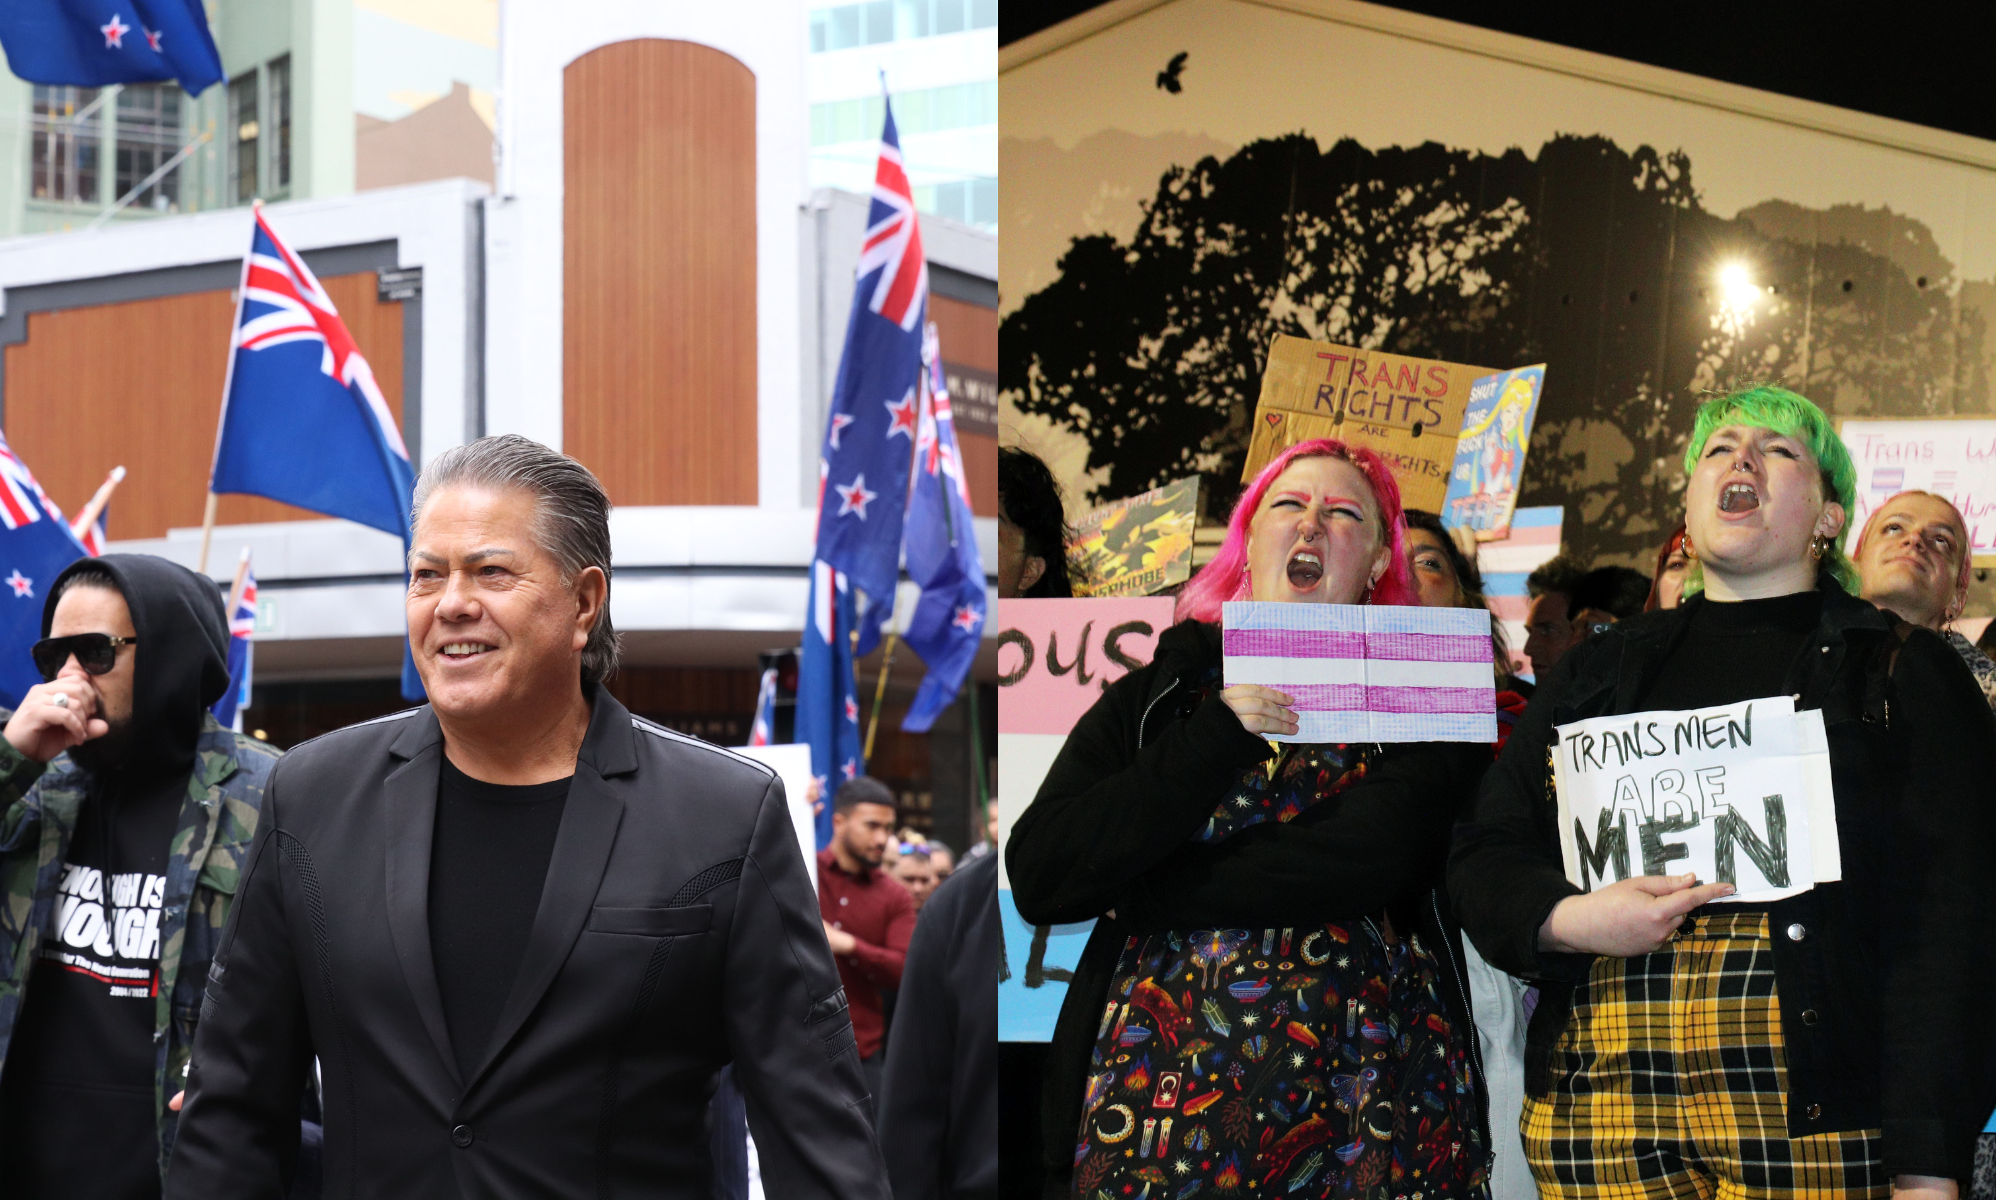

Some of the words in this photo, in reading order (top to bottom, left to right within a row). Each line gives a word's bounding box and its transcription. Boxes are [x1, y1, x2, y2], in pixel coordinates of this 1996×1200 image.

[1317, 352, 1448, 397] TRANS
[1469, 381, 1499, 403] SHUT
[1314, 384, 1443, 427] RIGHTS
[1467, 408, 1488, 427] THE
[1360, 424, 1389, 437] ARE
[1856, 433, 1935, 460] Trans
[1566, 720, 1666, 773] TRANS
[1674, 703, 1753, 755] MEN
[1609, 765, 1731, 827] ARE
[1574, 794, 1792, 896] MEN
[140, 873, 167, 909] IS
